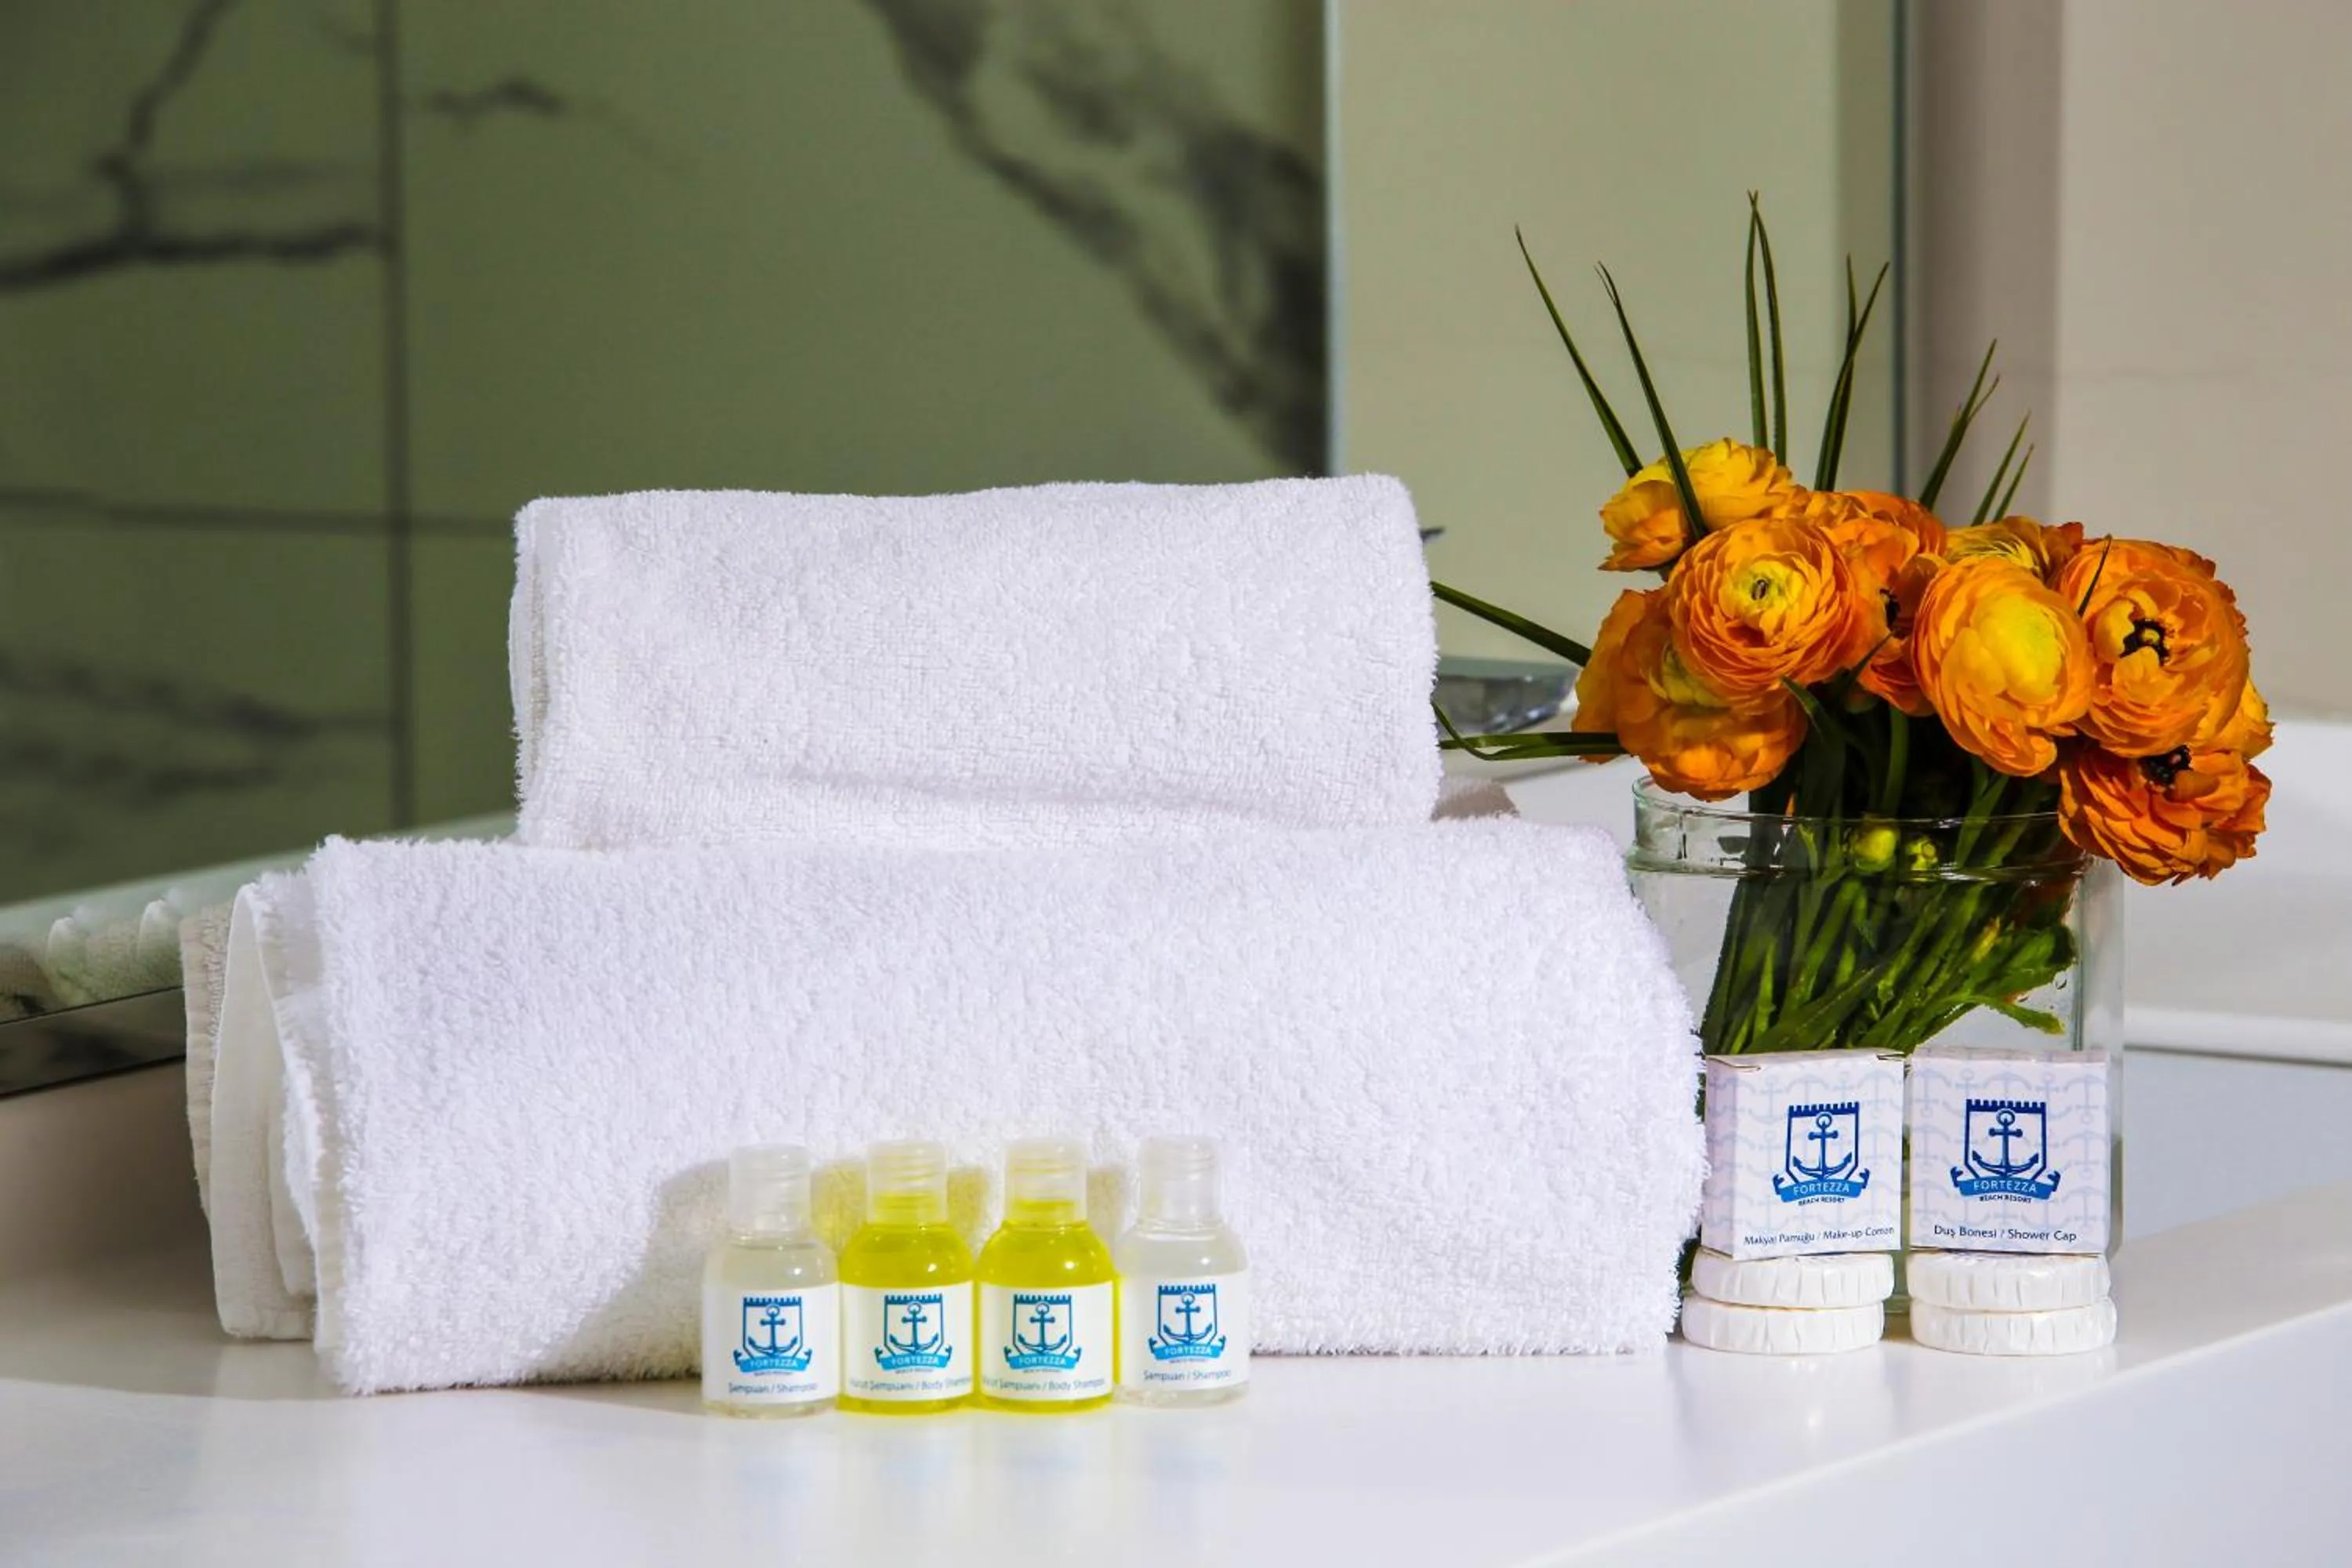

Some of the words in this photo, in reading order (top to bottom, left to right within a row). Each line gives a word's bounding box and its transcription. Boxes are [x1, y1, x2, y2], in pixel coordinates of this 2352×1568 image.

[1792, 1181, 1850, 1196] FORTEZZA
[1973, 1180, 2037, 1193] FORTEZZA
[1823, 1229, 1863, 1240] Make-up
[1934, 1225, 1955, 1239] Duş
[1959, 1226, 1997, 1238] Bonesi
[2008, 1229, 2050, 1241] Shower
[2053, 1230, 2077, 1243] Cap
[1164, 1345, 1212, 1356] FORTEZZA
[750, 1358, 798, 1368] FORTEZZA
[891, 1356, 940, 1366] FORTEZZA
[1019, 1356, 1067, 1365] FORTEZZA
[1193, 1368, 1232, 1380] Shampoo
